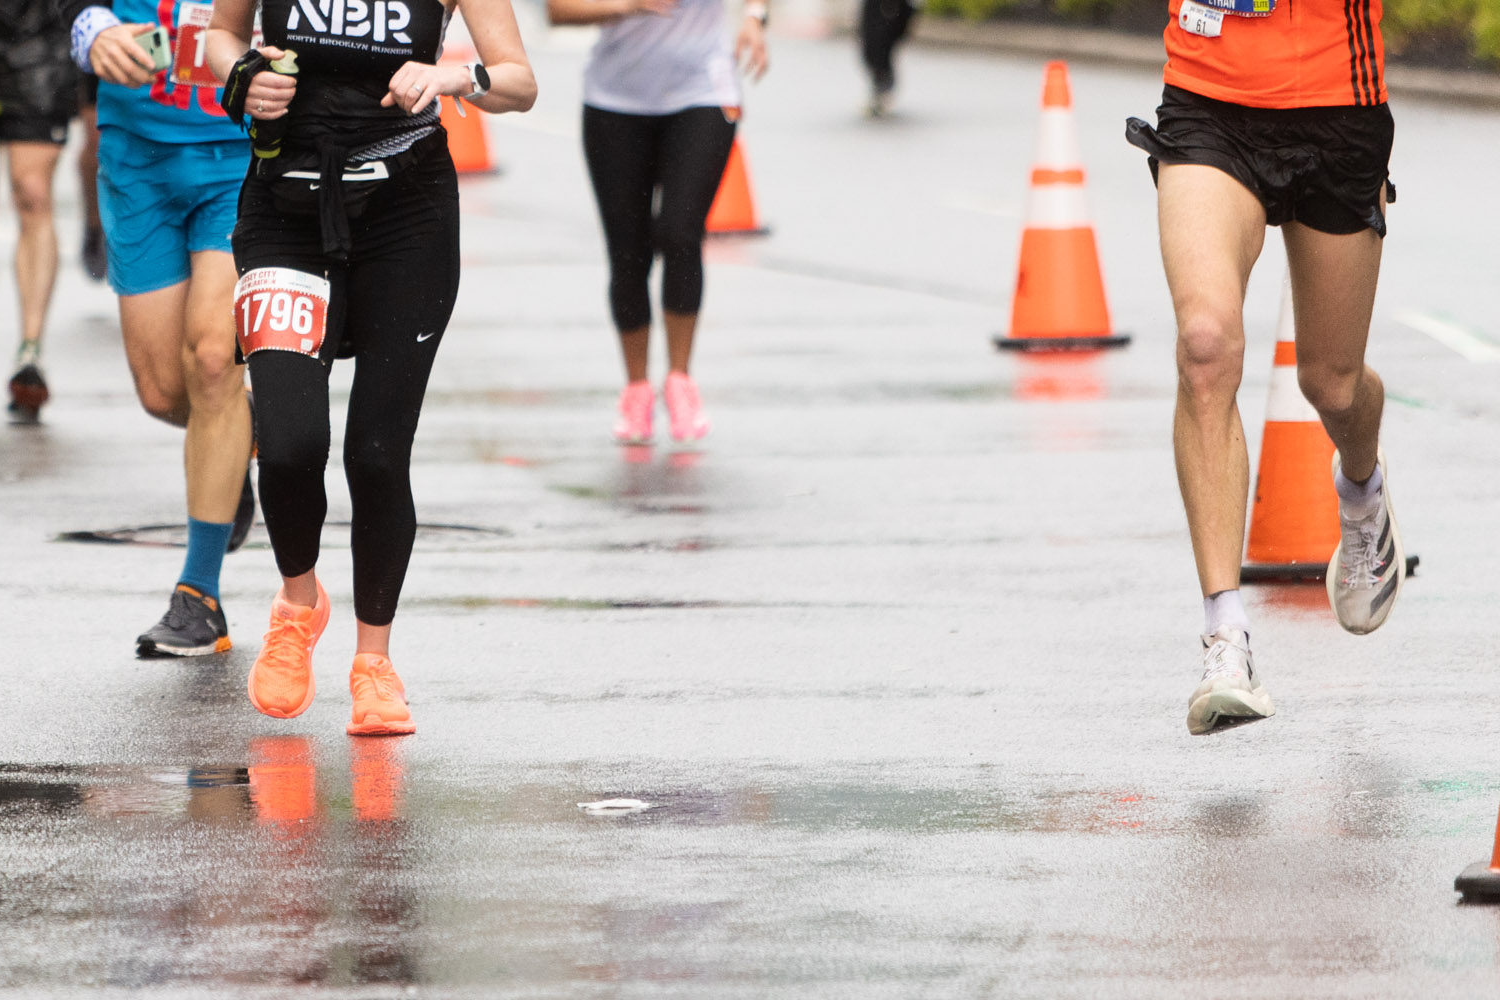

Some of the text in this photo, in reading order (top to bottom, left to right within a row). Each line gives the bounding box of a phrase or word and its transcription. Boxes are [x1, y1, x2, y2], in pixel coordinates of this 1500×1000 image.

[1196, 19, 1207, 34] 61
[286, 34, 317, 44] NORTH
[319, 37, 369, 52] BROOKLYN
[241, 291, 314, 337] 1796
